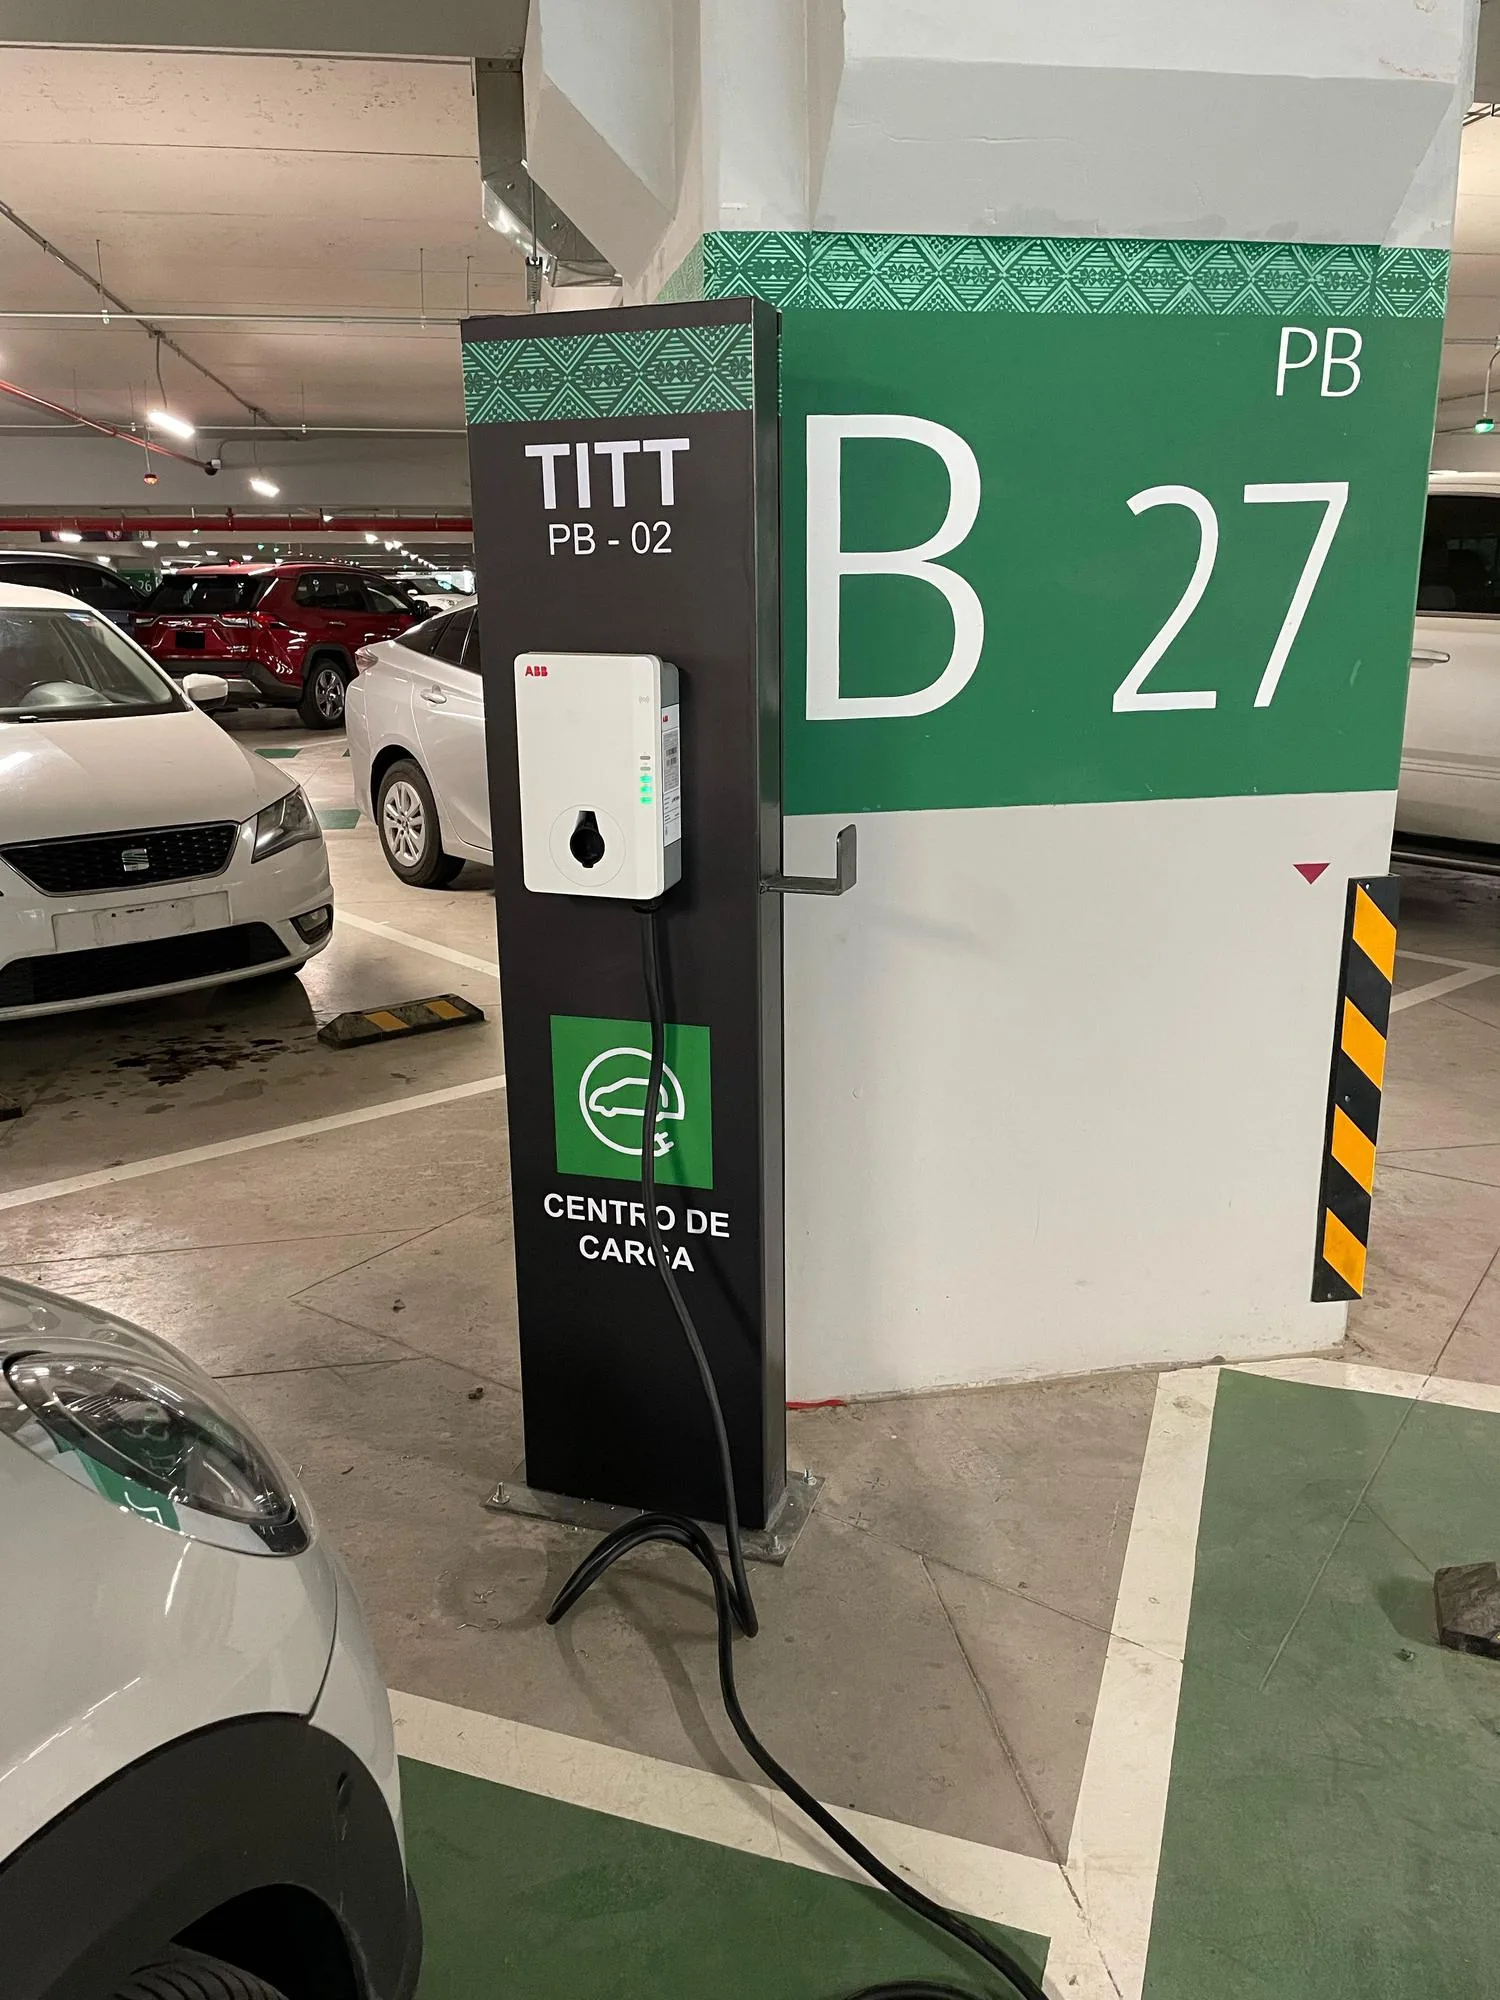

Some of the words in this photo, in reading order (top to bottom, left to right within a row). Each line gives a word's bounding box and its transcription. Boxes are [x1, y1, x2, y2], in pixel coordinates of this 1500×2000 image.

[1275, 326, 1363, 397] PB
[524, 437, 690, 510] TITT
[548, 523, 596, 556] PB
[631, 520, 672, 555] 02
[805, 414, 985, 721] B
[1112, 481, 1350, 713] 27
[524, 665, 549, 678] ABB
[543, 1192, 676, 1231] CENTRO
[686, 1208, 730, 1238] DE
